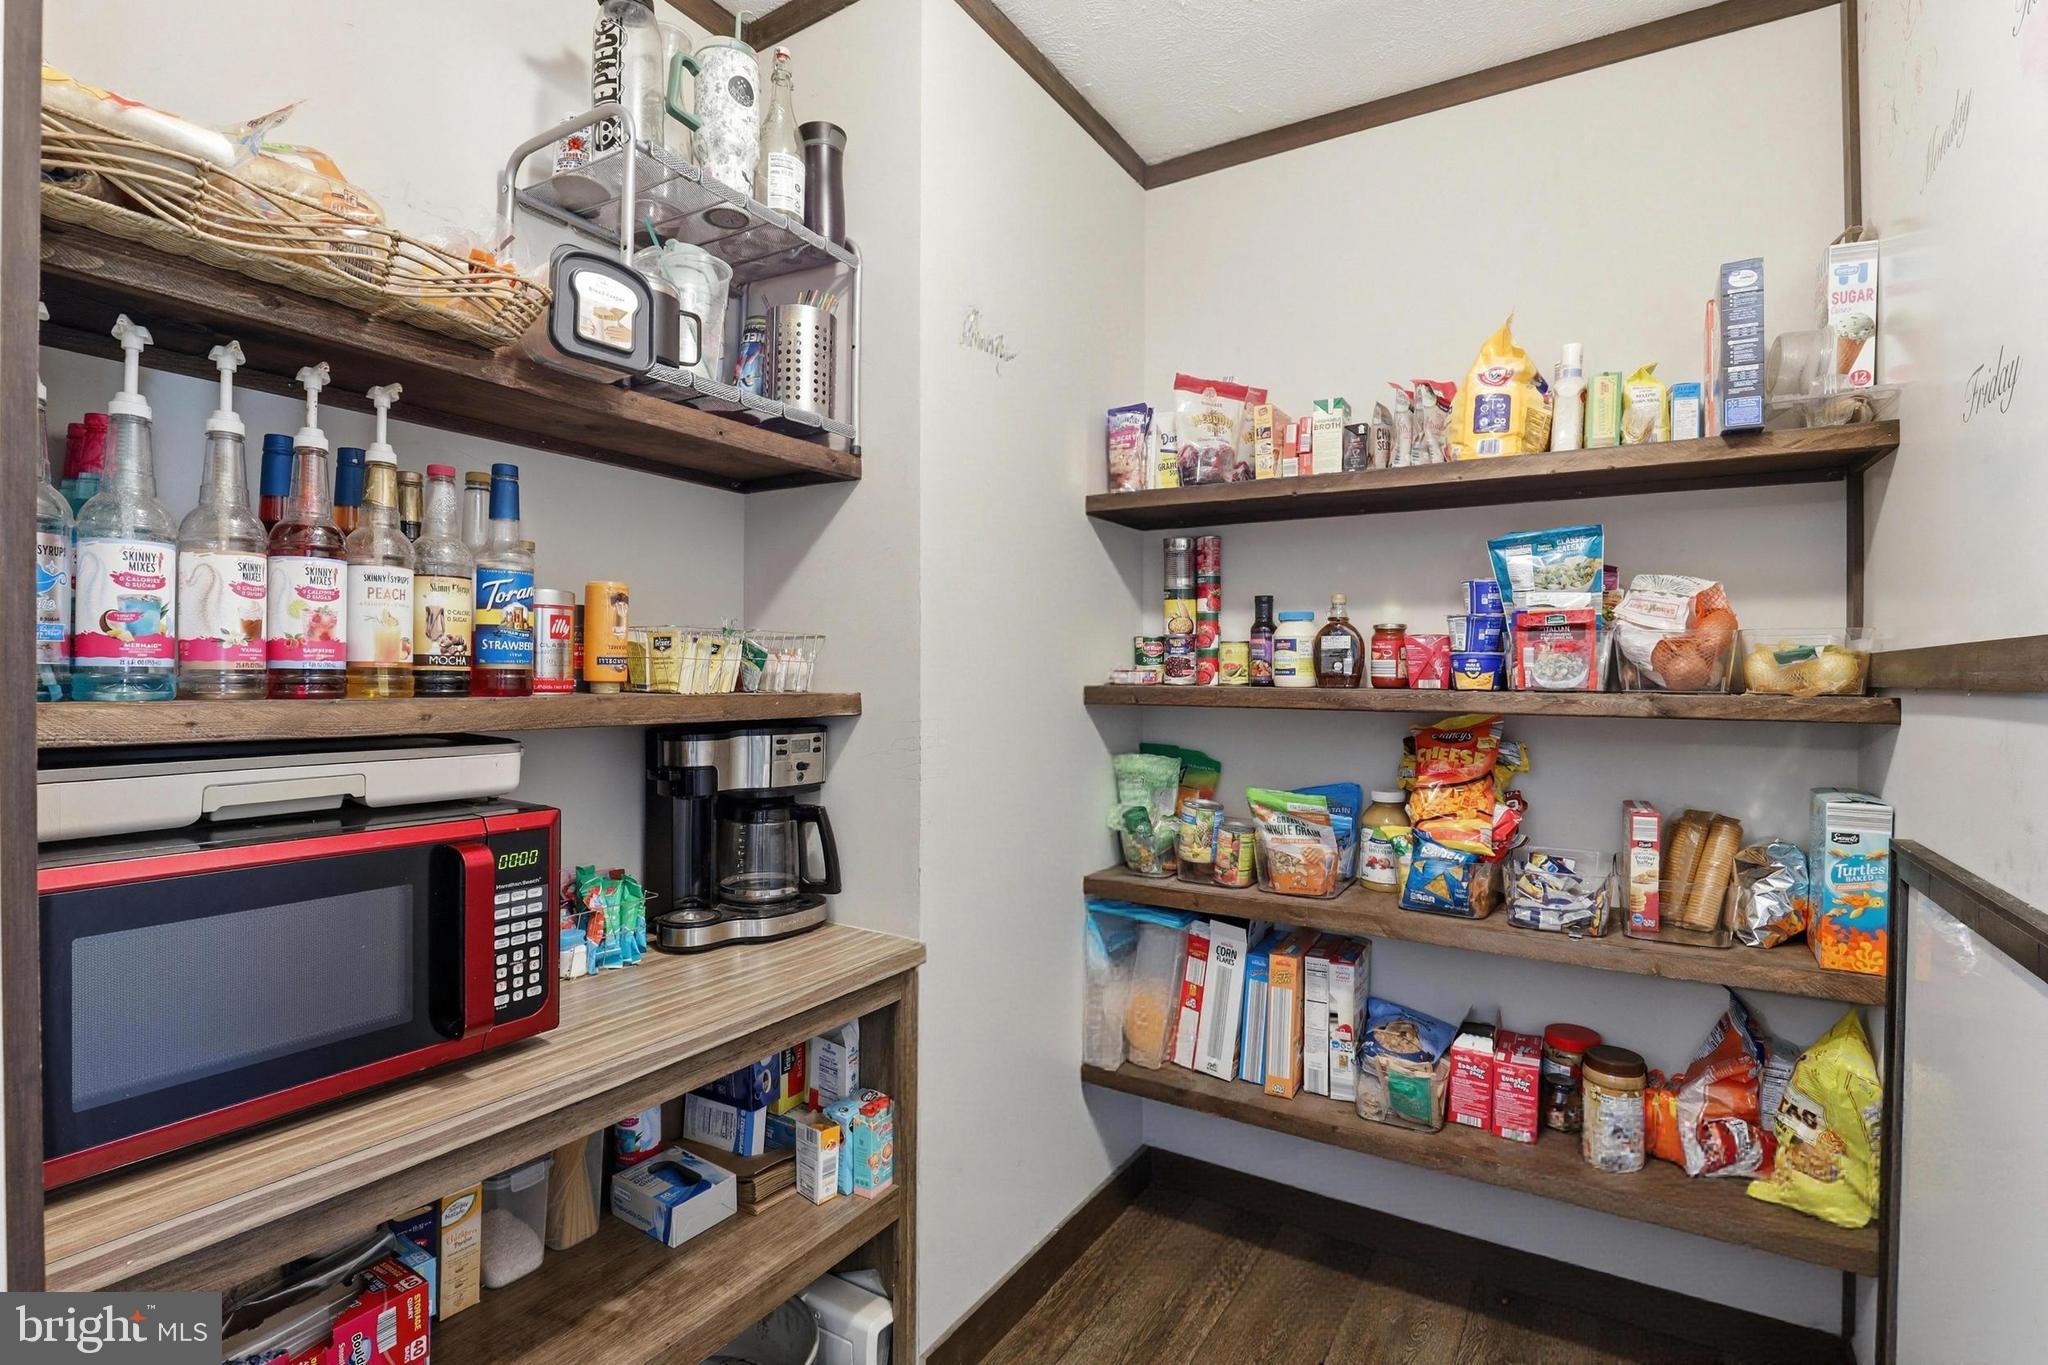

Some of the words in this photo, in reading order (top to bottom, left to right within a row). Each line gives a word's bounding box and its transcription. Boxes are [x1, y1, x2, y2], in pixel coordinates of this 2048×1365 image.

[594, 18, 619, 88] PIECE
[1831, 288, 1874, 306] SUGAR
[1854, 371, 1867, 383] 12
[1963, 344, 2022, 424] Friday
[1312, 422, 1342, 432] BROTH
[1556, 536, 1587, 546] CLASSIC
[122, 550, 157, 562] SKINNY
[128, 561, 156, 573] MIXES
[237, 561, 262, 573] SKINNY
[305, 566, 333, 577] SKINNY
[242, 572, 262, 582] MIXES
[309, 575, 332, 586] MIXES
[363, 573, 387, 582] SKINNY
[367, 586, 407, 600] PEACH
[429, 583, 451, 593] Skinny
[551, 618, 570, 638] illy
[428, 655, 467, 666] MOCHA
[1417, 746, 1486, 766] CHEESE
[1264, 824, 1293, 835] WHOLE
[1295, 825, 1322, 838] GRAIN
[1421, 843, 1465, 862] RANCH
[1834, 863, 1886, 879] Turtles
[1845, 875, 1875, 883] BAKED
[495, 881, 522, 890] Hamilton
[1216, 944, 1238, 960] CORN
[1216, 955, 1235, 967] FLAKES
[404, 1275, 420, 1289] 40
[407, 1297, 415, 1320] QUART
[413, 1293, 422, 1332] STORAGE
[413, 1339, 424, 1358] 40
